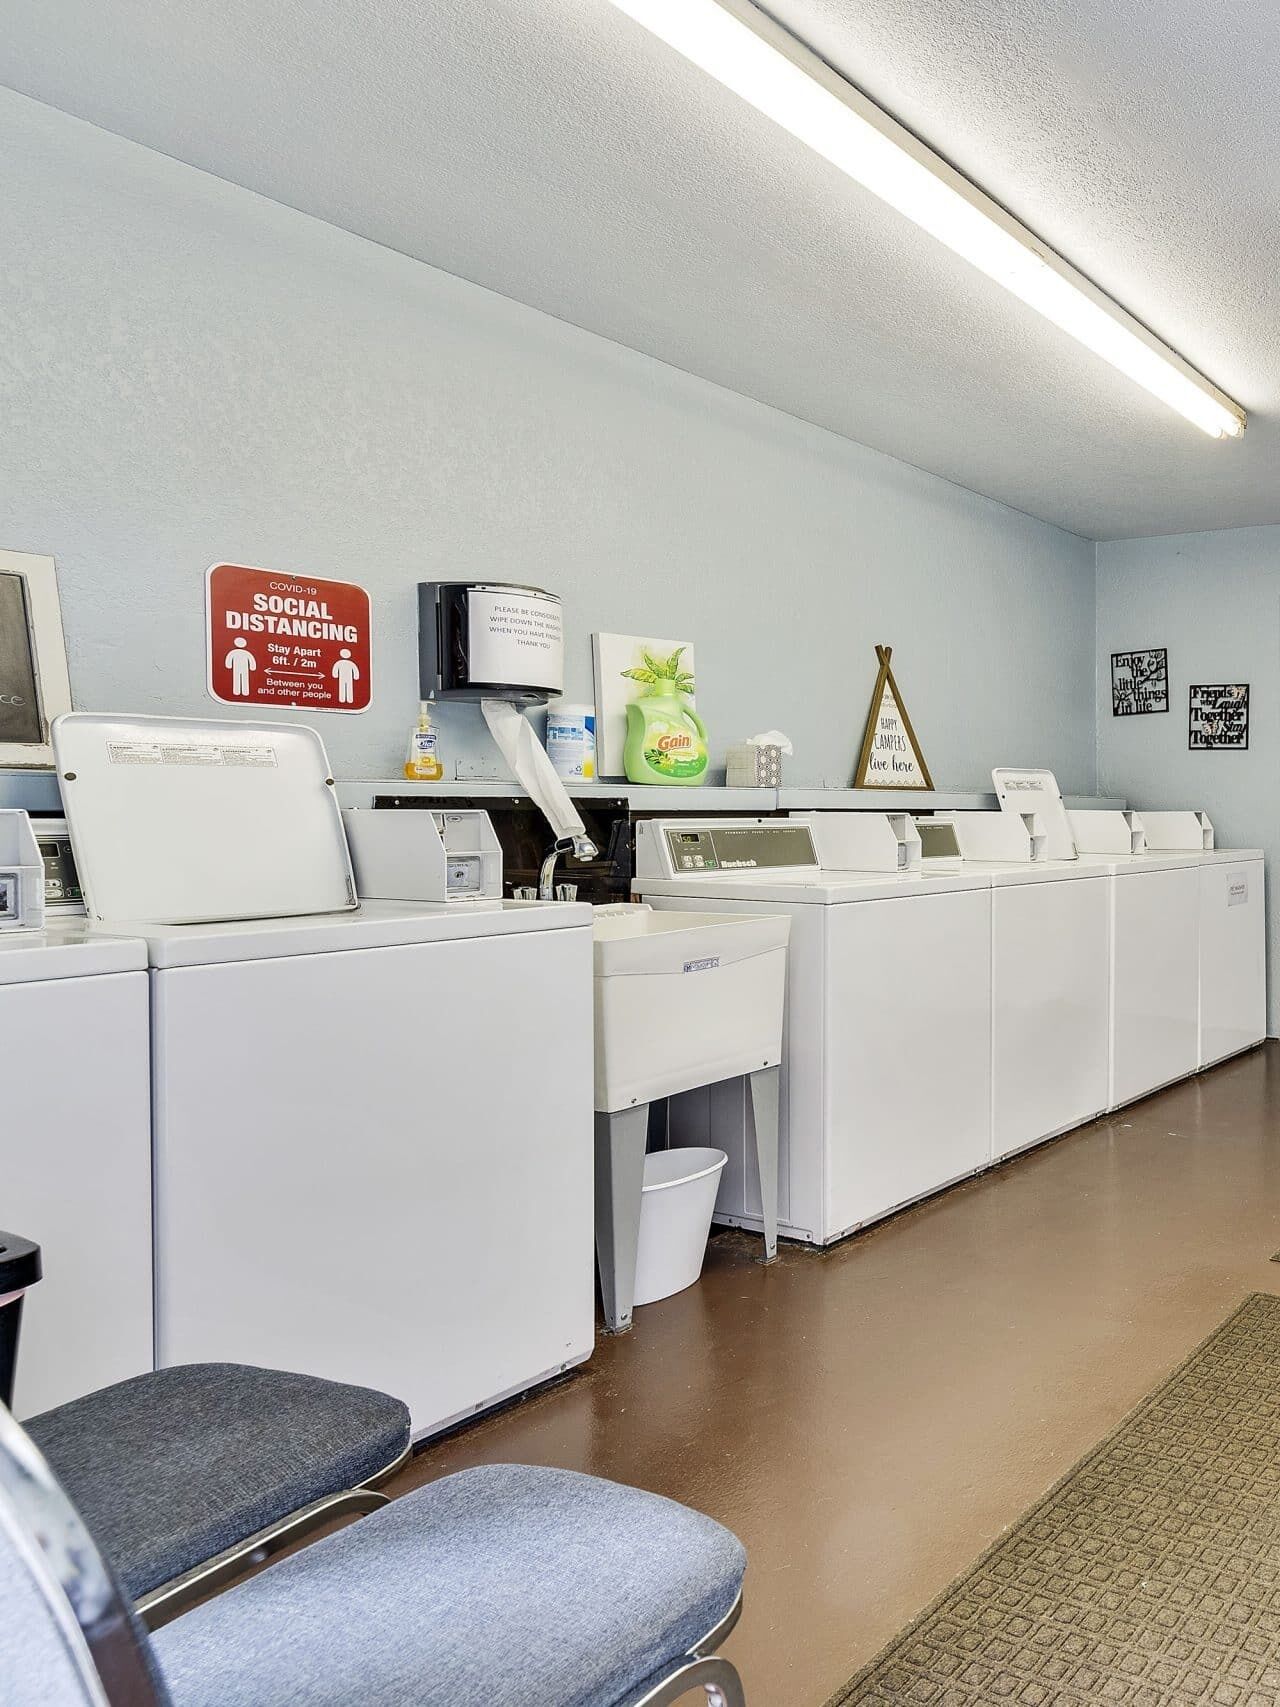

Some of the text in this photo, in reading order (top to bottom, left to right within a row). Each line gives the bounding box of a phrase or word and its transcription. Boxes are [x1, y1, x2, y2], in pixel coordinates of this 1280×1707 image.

[270, 582, 317, 596] COVID-19
[253, 593, 333, 620] SOCIAL
[494, 605, 520, 614] PLEASE
[226, 610, 358, 643] DISTANCING
[510, 618, 532, 626] DOWN
[514, 628, 528, 636] YOU
[530, 630, 544, 638] HAVE
[267, 643, 322, 657] Stay Apart
[517, 640, 538, 648] THANK
[272, 656, 290, 666] 6ft.
[301, 658, 317, 668] 2m
[1116, 656, 1146, 670] Enjoy
[266, 678, 306, 688] Between
[1118, 677, 1143, 690] little
[277, 688, 300, 696] other
[302, 690, 332, 699] people
[1134, 687, 1166, 702] things
[1192, 686, 1232, 699] Friends
[1120, 700, 1152, 712] in life
[1190, 708, 1244, 722] Together
[880, 718, 898, 731] HAPPY
[657, 734, 690, 750] Gain
[874, 734, 906, 752] CAMPERS
[1190, 730, 1244, 746] Together
[870, 752, 914, 773] live here
